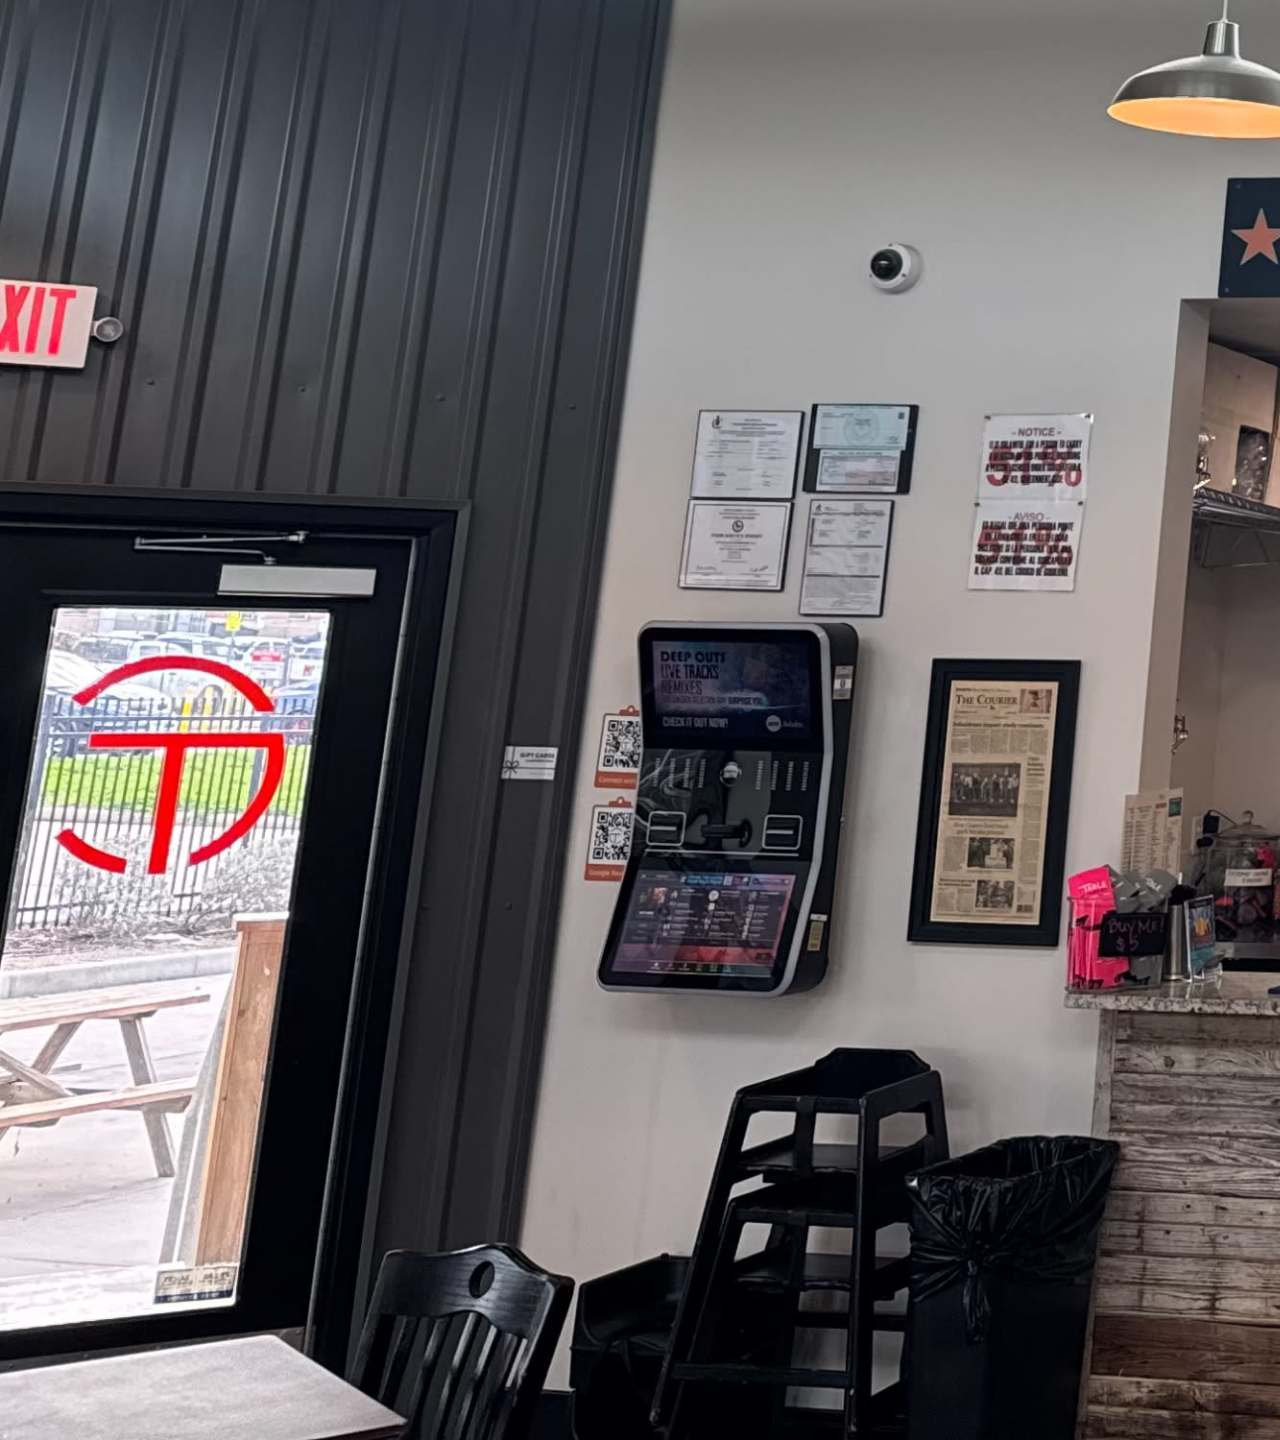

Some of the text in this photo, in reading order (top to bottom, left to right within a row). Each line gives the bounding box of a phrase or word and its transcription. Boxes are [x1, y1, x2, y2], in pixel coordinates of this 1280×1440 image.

[0, 285, 76, 356] XIT
[1018, 427, 1056, 436] NOTICE
[660, 651, 692, 662] DEEP
[660, 664, 720, 679] LIVE TRACKS
[955, 694, 1018, 705] THE COURIER
